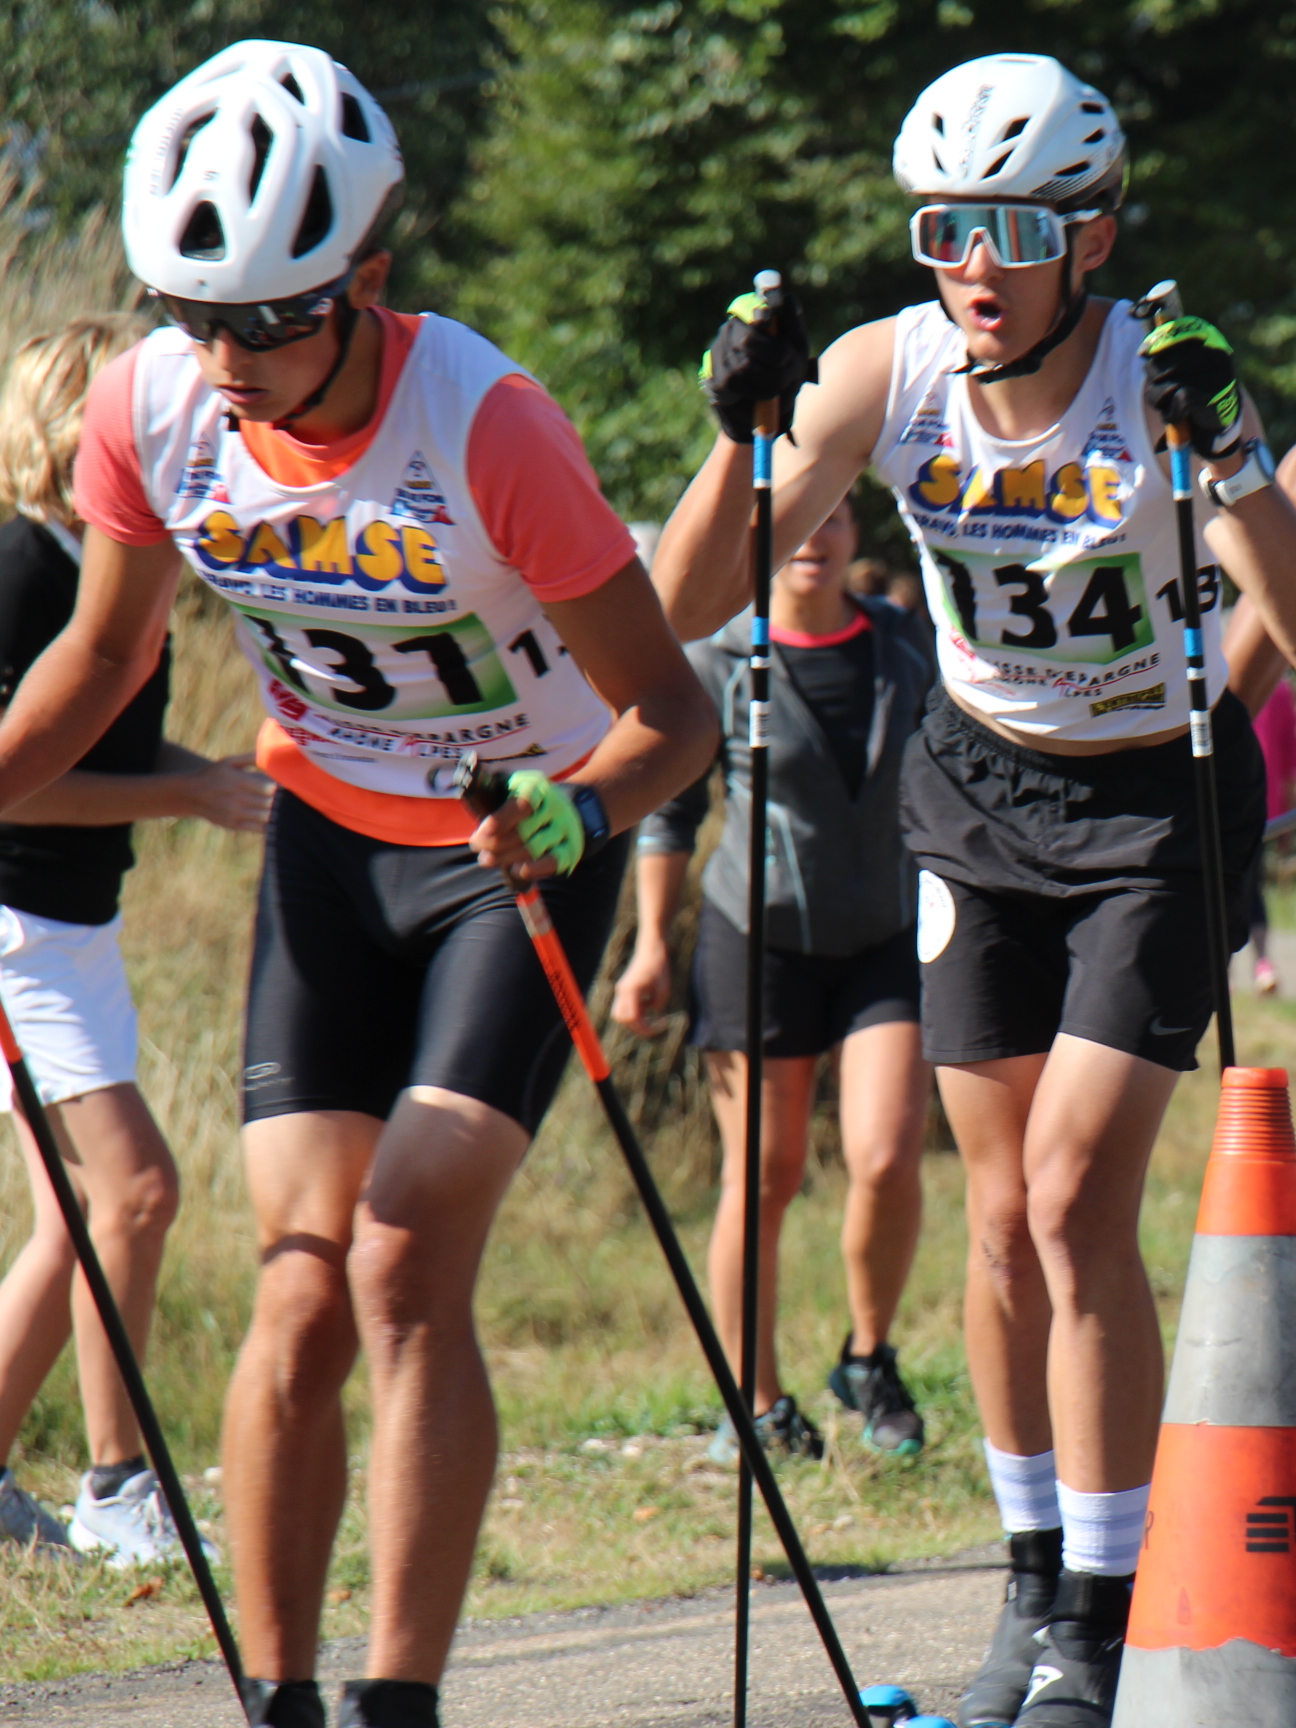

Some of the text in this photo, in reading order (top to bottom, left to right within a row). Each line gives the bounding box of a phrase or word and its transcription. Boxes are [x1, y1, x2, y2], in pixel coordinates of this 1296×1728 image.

[908, 454, 1123, 530] SAMSE
[963, 523, 987, 537] LES
[191, 509, 449, 595] SAMSE
[934, 548, 1142, 653] 134
[243, 613, 484, 712] 131
